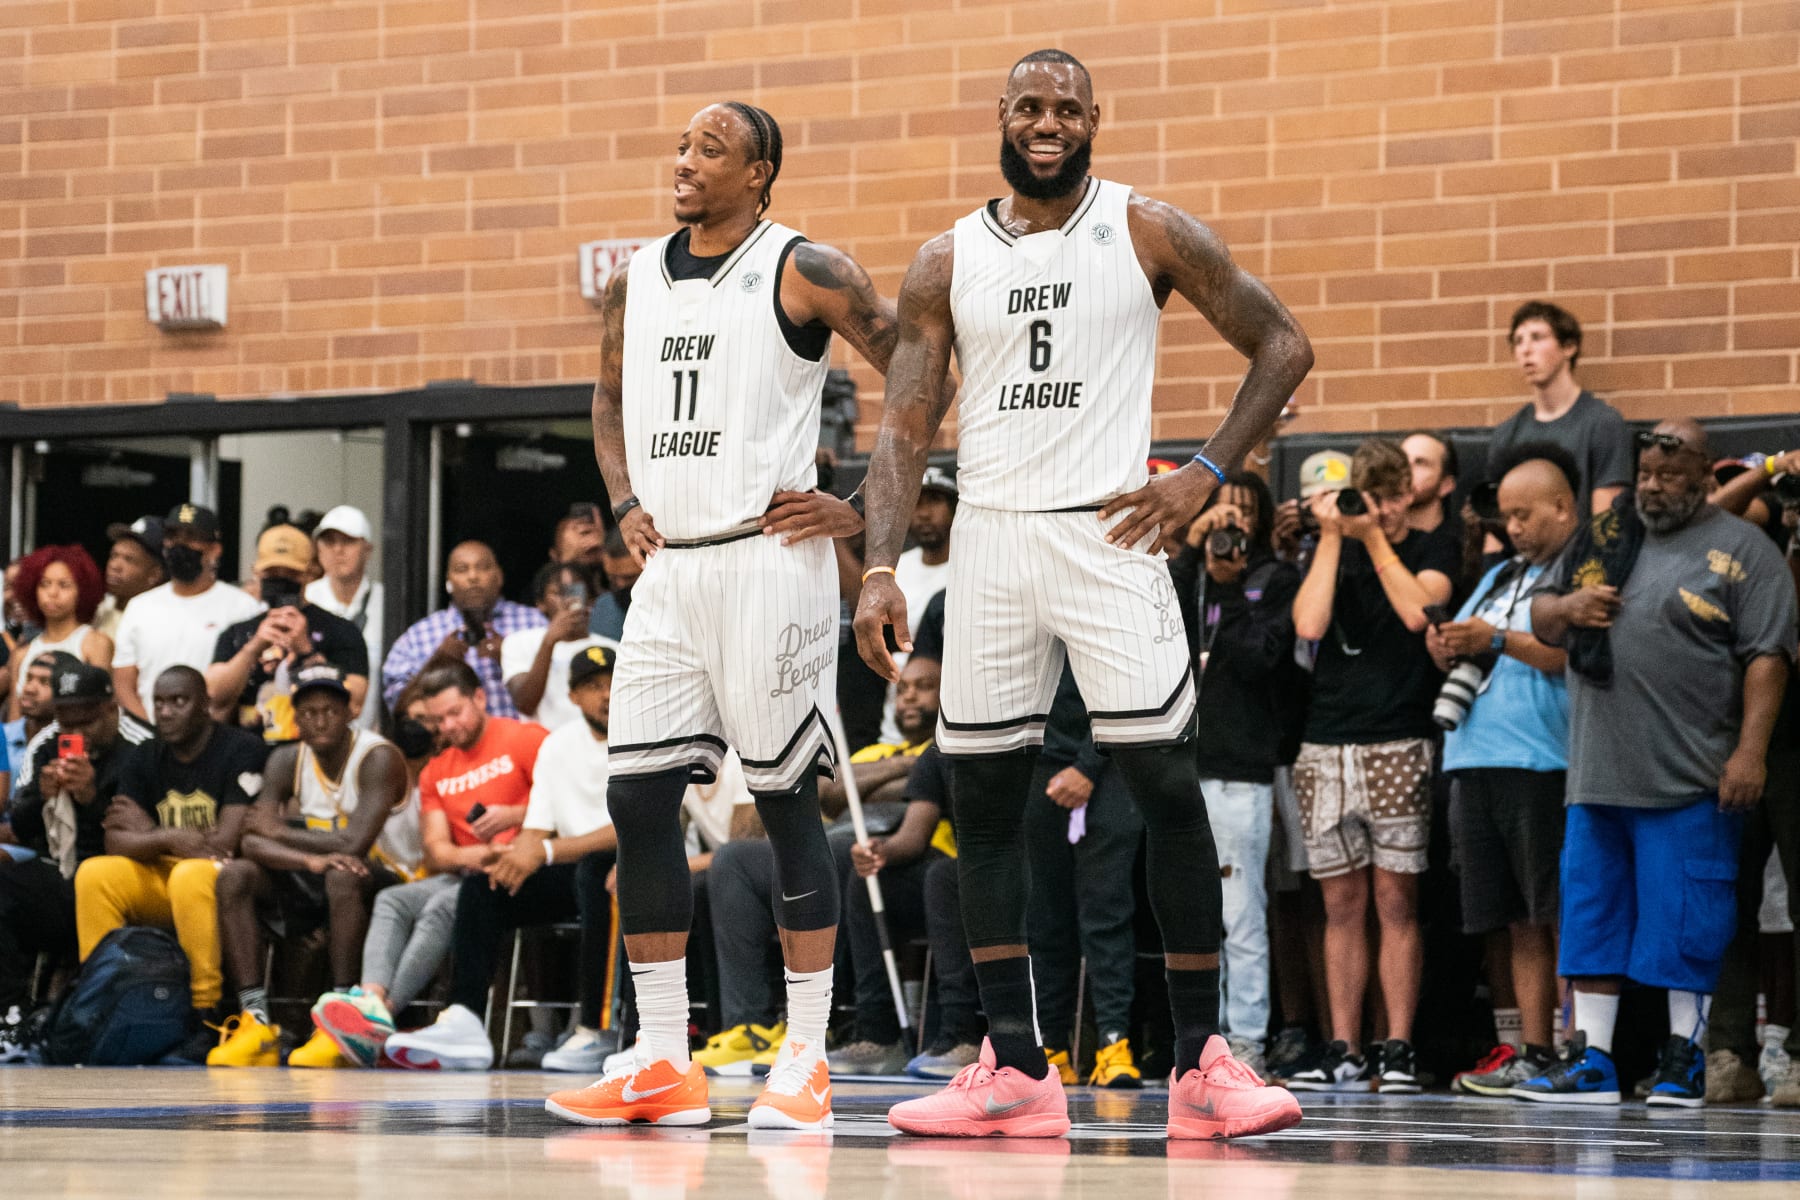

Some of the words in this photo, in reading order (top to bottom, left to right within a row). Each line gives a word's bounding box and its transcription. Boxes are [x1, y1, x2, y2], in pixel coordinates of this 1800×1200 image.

[592, 245, 641, 294] EX
[157, 271, 203, 320] EXIT
[1008, 282, 1072, 315] DREW
[660, 334, 716, 362] DREW
[1029, 319, 1052, 372] 6
[672, 369, 699, 422] 11
[998, 382, 1083, 411] LEAGUE
[650, 430, 722, 459] LEAGUE
[775, 614, 833, 662] Drew
[770, 646, 834, 698] League
